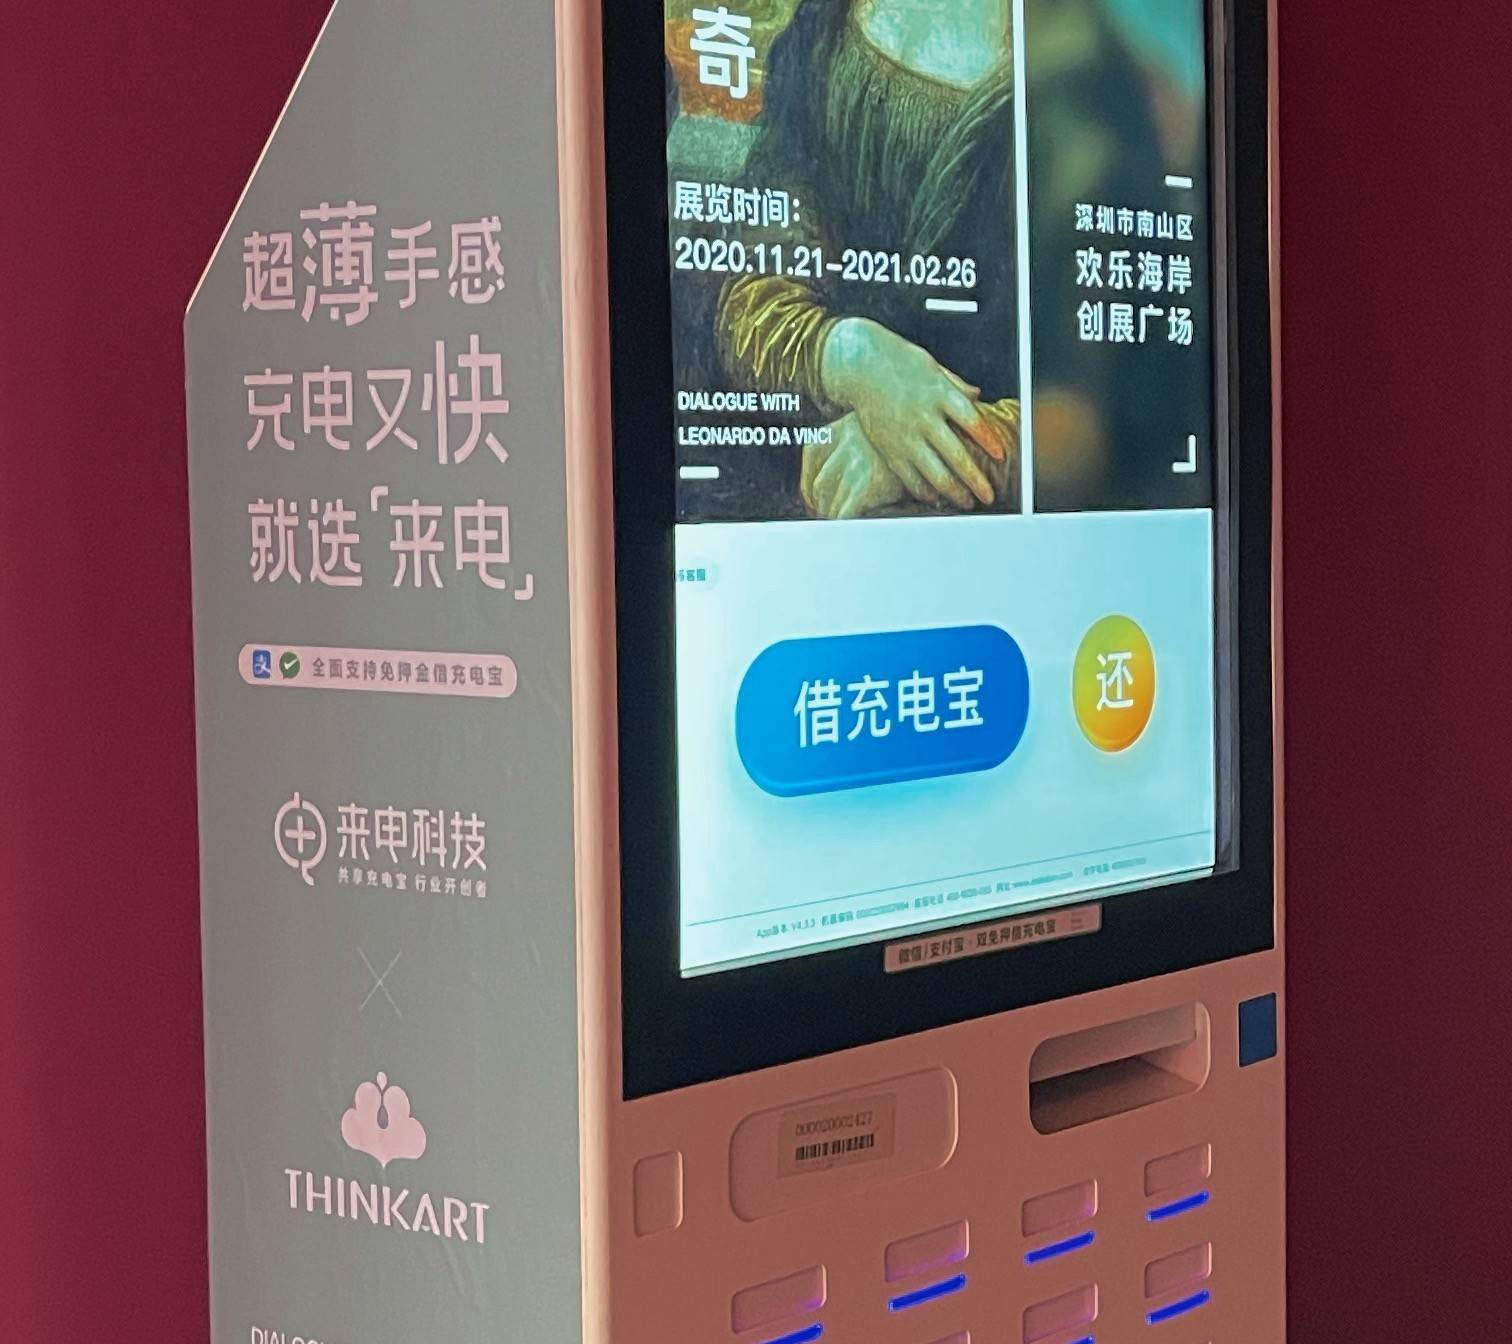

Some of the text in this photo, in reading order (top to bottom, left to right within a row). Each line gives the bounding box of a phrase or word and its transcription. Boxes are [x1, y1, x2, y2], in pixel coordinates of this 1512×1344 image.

[1075, 203, 1195, 242] 深圳市南山区
[242, 200, 505, 327] 超薄手感
[1075, 248, 1194, 295] 欢乐海岸
[1077, 300, 1195, 347] 创展广场
[243, 333, 510, 465] 充电又快
[678, 390, 800, 411] DIALOGUE WITH
[678, 426, 832, 446] LEONARDO DA VINCI
[311, 656, 504, 688] 全面支持免押金借充电宝
[1096, 650, 1134, 713] 还
[793, 665, 985, 749] 借充电宝
[336, 802, 487, 872] 来电科技
[284, 1168, 490, 1244] THINKART
